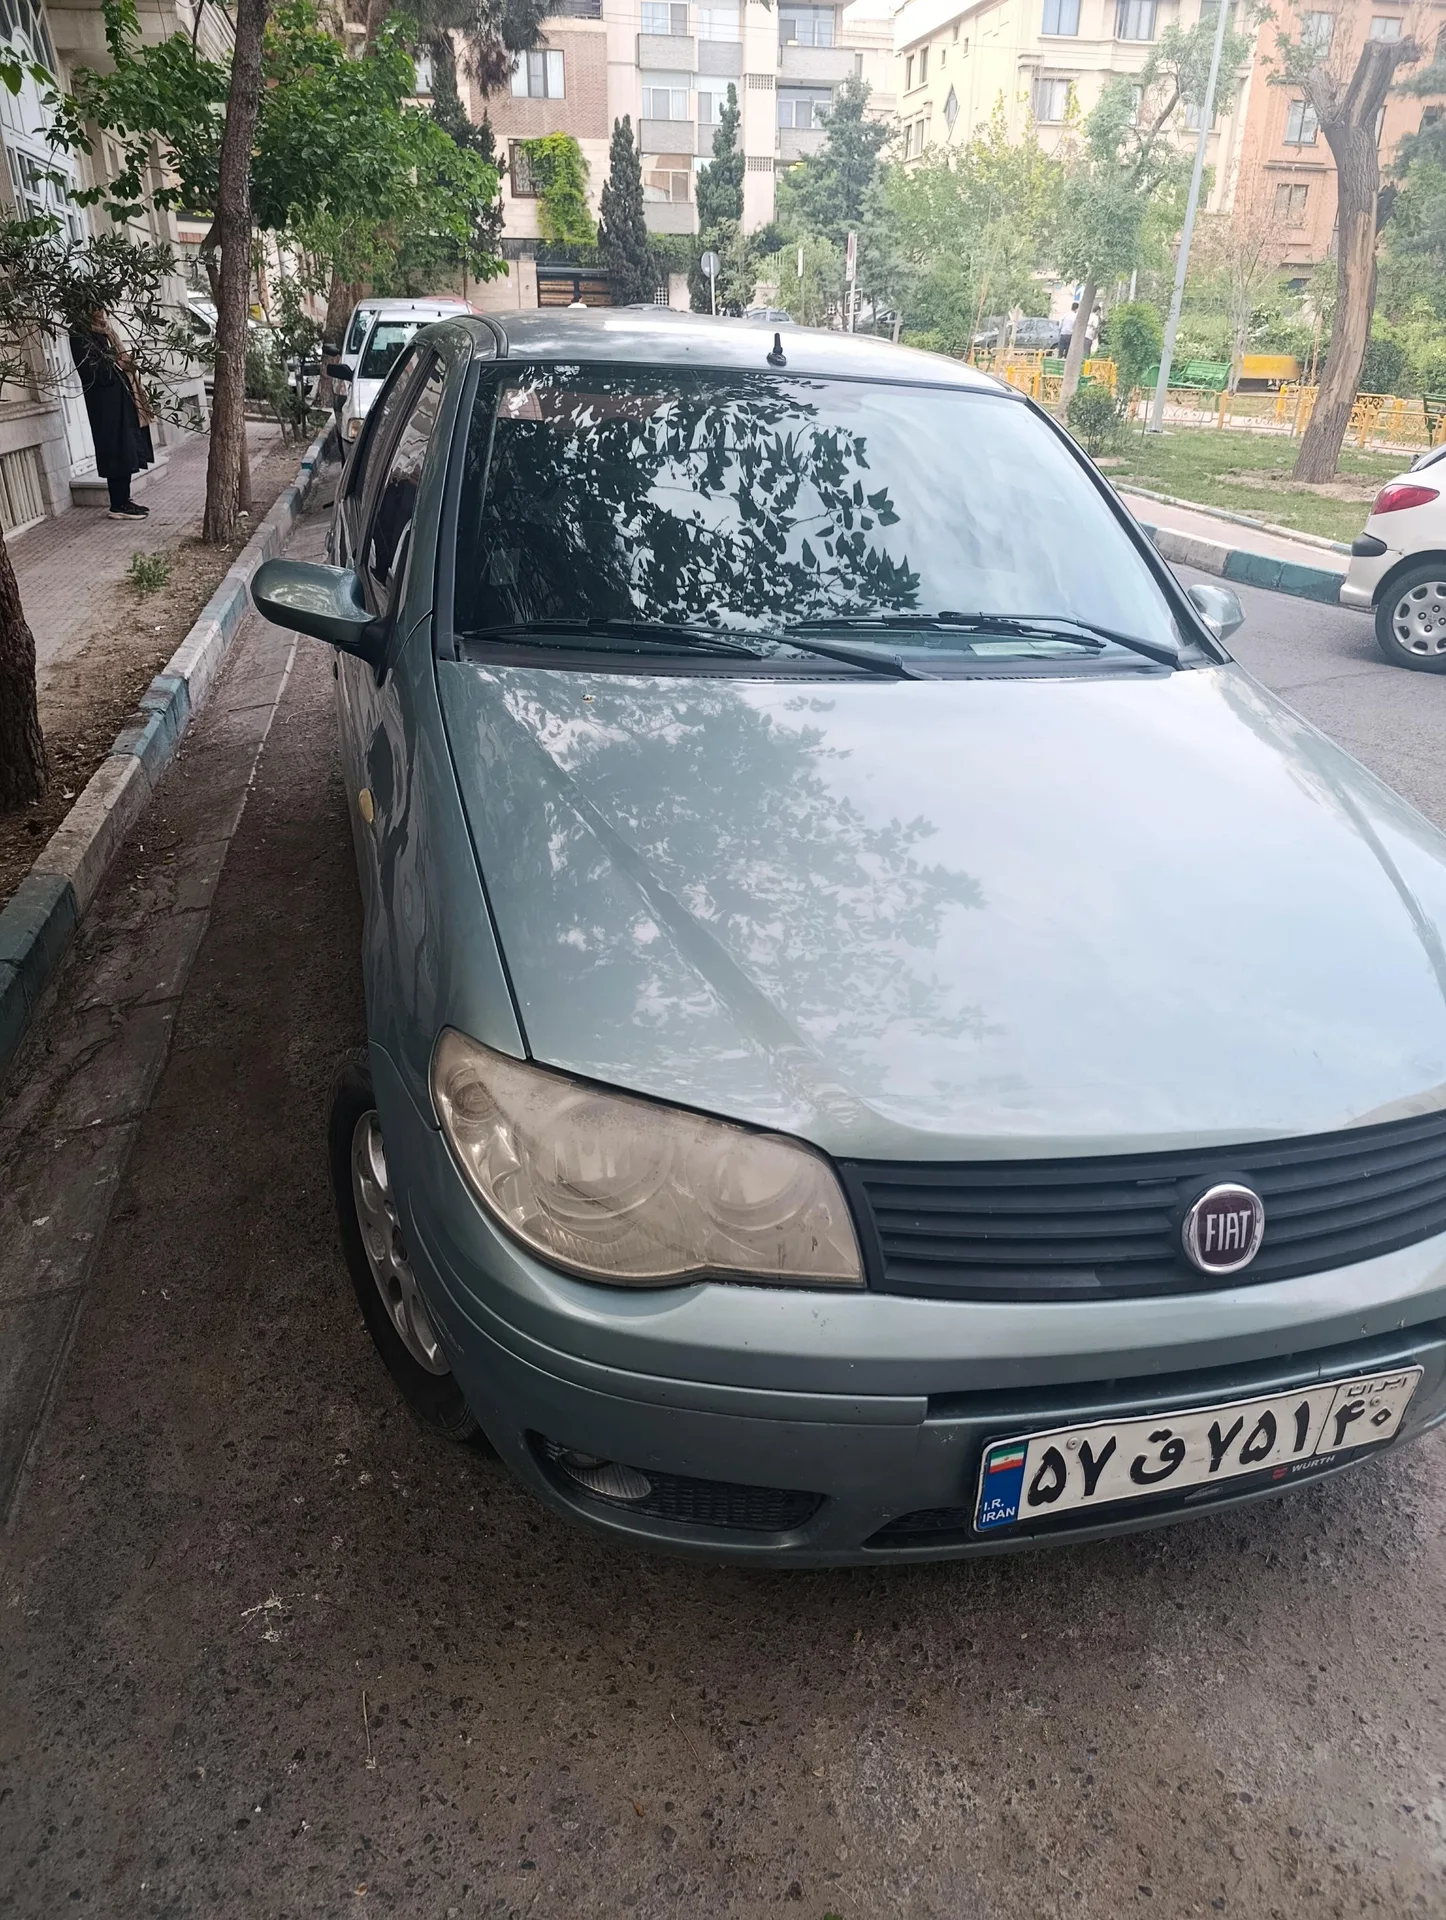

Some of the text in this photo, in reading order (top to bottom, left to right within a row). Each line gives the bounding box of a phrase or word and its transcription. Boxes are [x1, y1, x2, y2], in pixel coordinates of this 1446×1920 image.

[1205, 1210, 1251, 1252] FIAT
[983, 1498, 1005, 1511] I.R.
[982, 1507, 1016, 1523] IRAN
